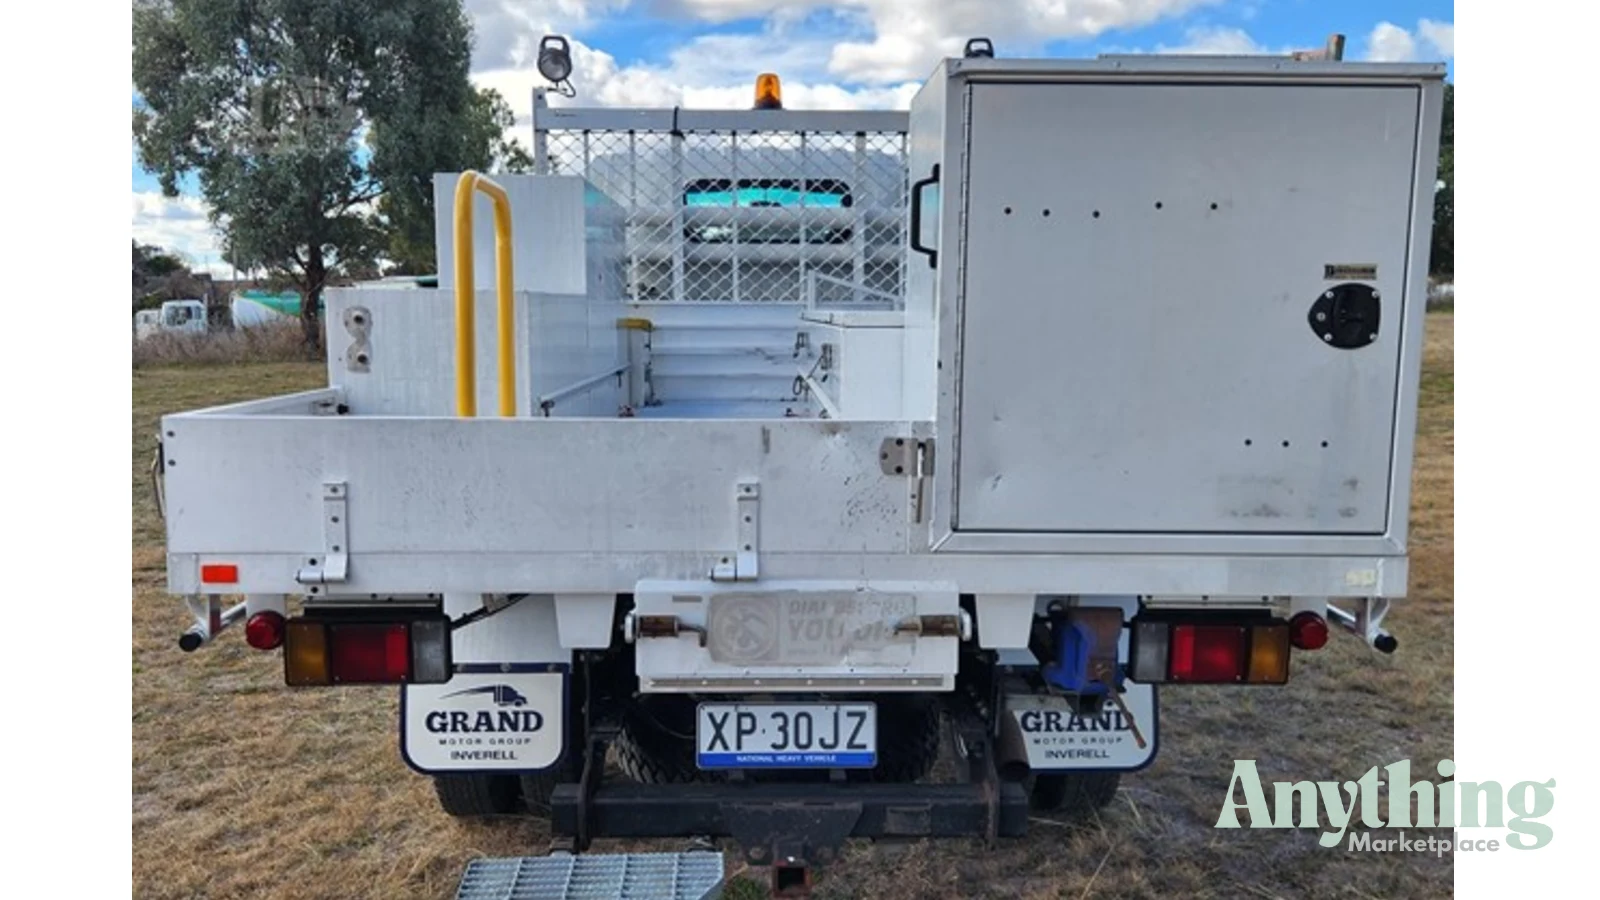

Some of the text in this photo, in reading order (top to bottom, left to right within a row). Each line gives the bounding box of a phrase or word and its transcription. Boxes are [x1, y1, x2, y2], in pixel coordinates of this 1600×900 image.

[788, 618, 845, 641] YOU
[425, 710, 544, 733] GRAND
[1033, 737, 1122, 745] MOTOR GROUP
[450, 750, 518, 760] INVERELL
[736, 755, 837, 763] NATIONAL HEAVY VEHICLE
[1044, 749, 1110, 759] INVERELL
